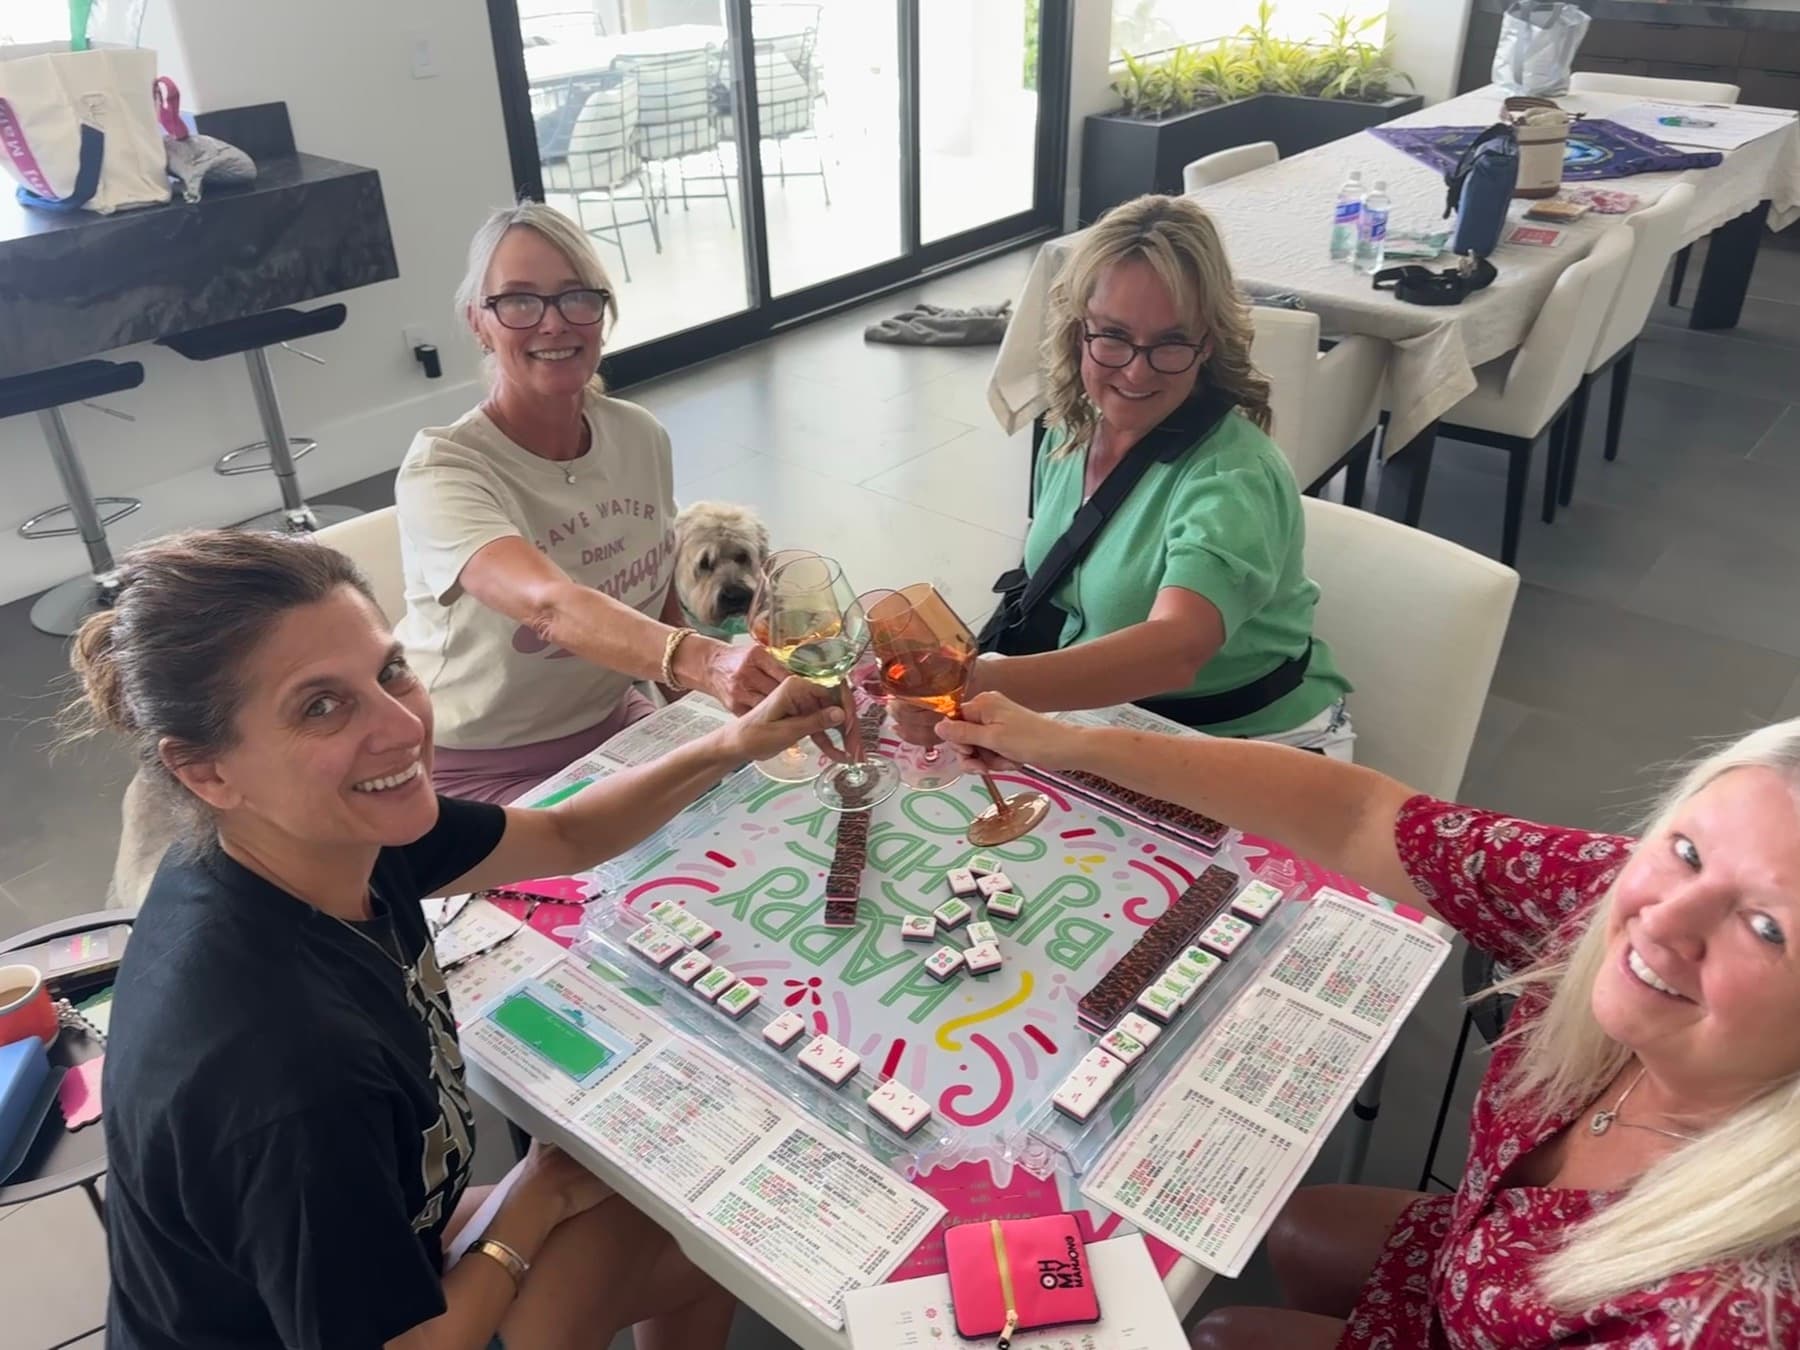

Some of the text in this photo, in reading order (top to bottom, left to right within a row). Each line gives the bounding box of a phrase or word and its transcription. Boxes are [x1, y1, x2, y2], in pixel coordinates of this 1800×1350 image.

[535, 498, 655, 554] SAVE WATER
[582, 536, 625, 565] DRINK
[707, 866, 965, 1024] HAPPY
[1037, 1260, 1057, 1290] OH
[1055, 1261, 1074, 1288] MY
[1065, 1235, 1084, 1288] MAHJONG
